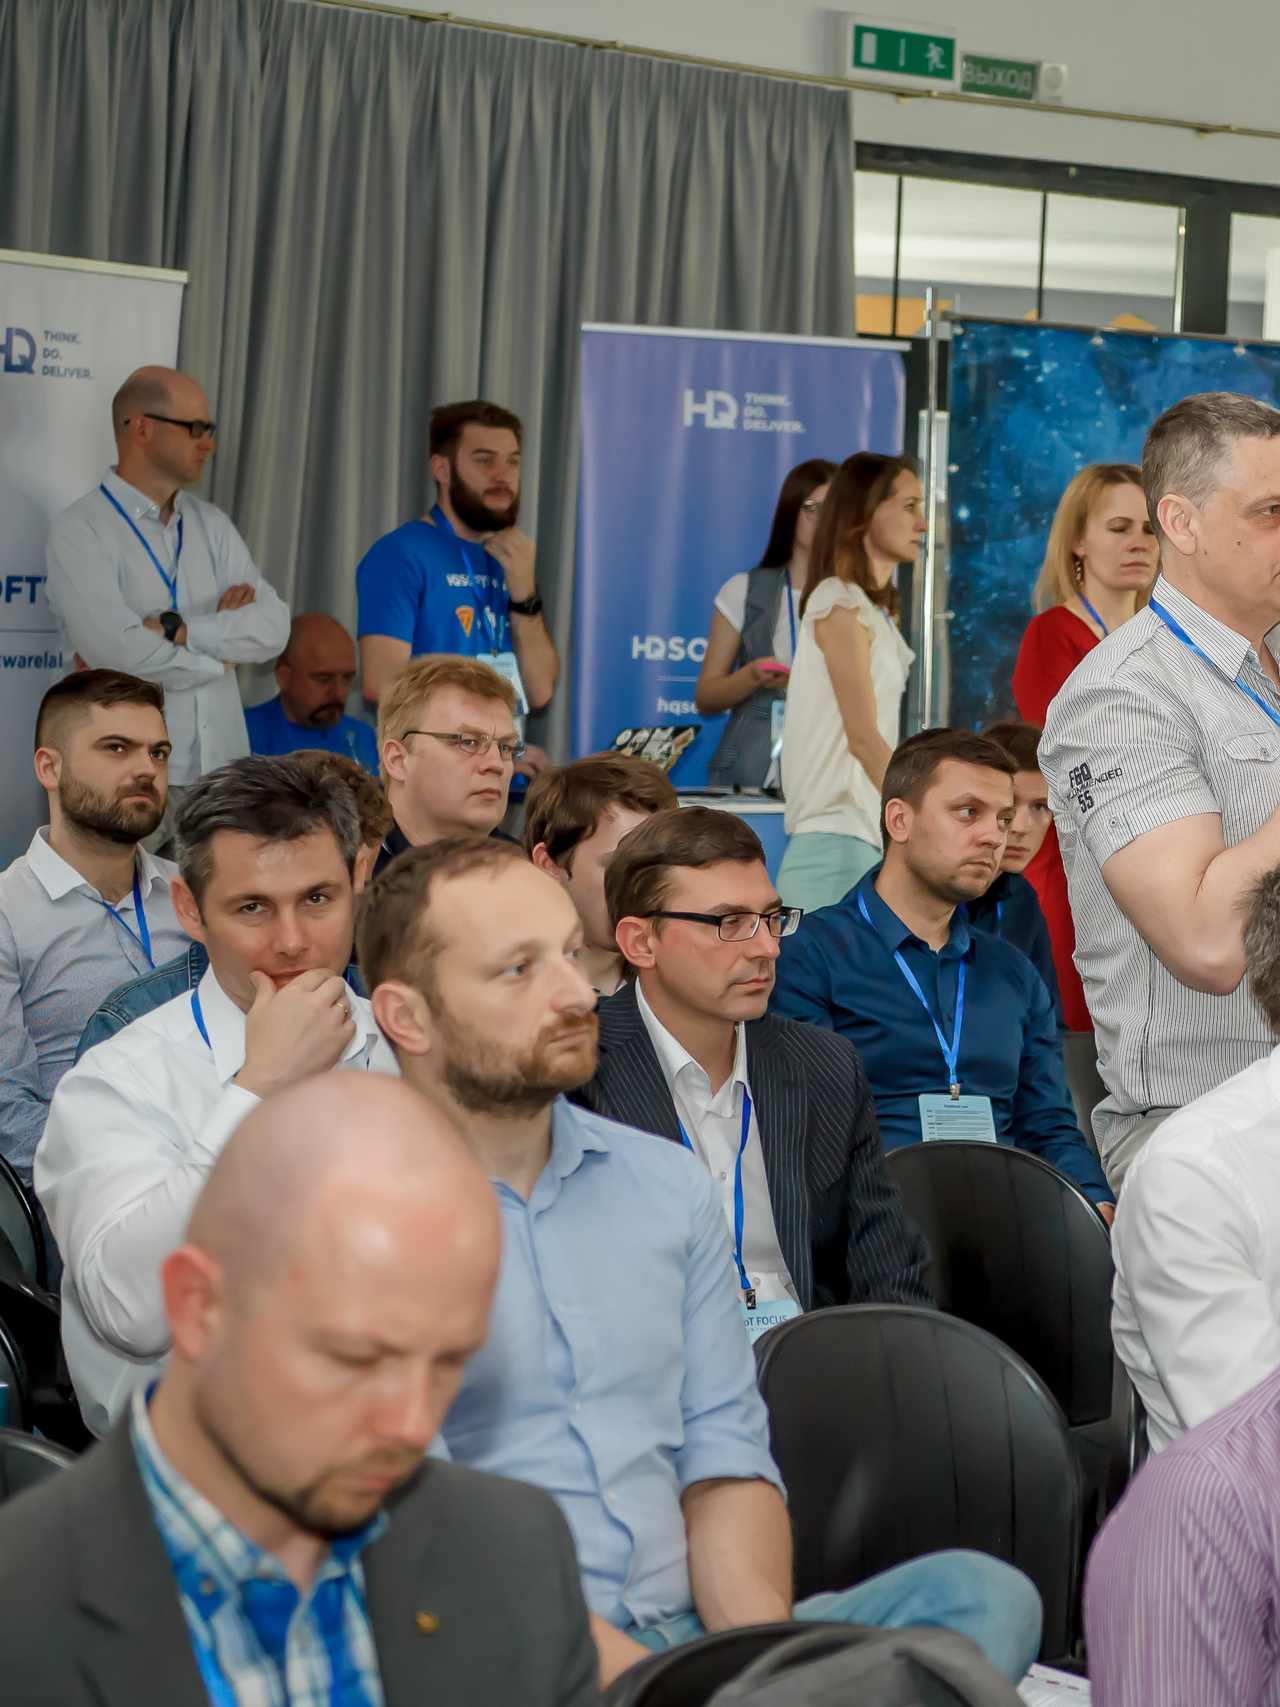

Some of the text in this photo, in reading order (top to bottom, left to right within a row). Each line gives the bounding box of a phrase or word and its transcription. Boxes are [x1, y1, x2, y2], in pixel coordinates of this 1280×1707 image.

[963, 62, 1032, 95] ВЫХОД
[43, 330, 82, 345] THINK.
[42, 347, 63, 361] DO.
[42, 365, 94, 380] DELIVER.
[683, 389, 739, 429] HQ
[743, 1316, 755, 1326] oT
